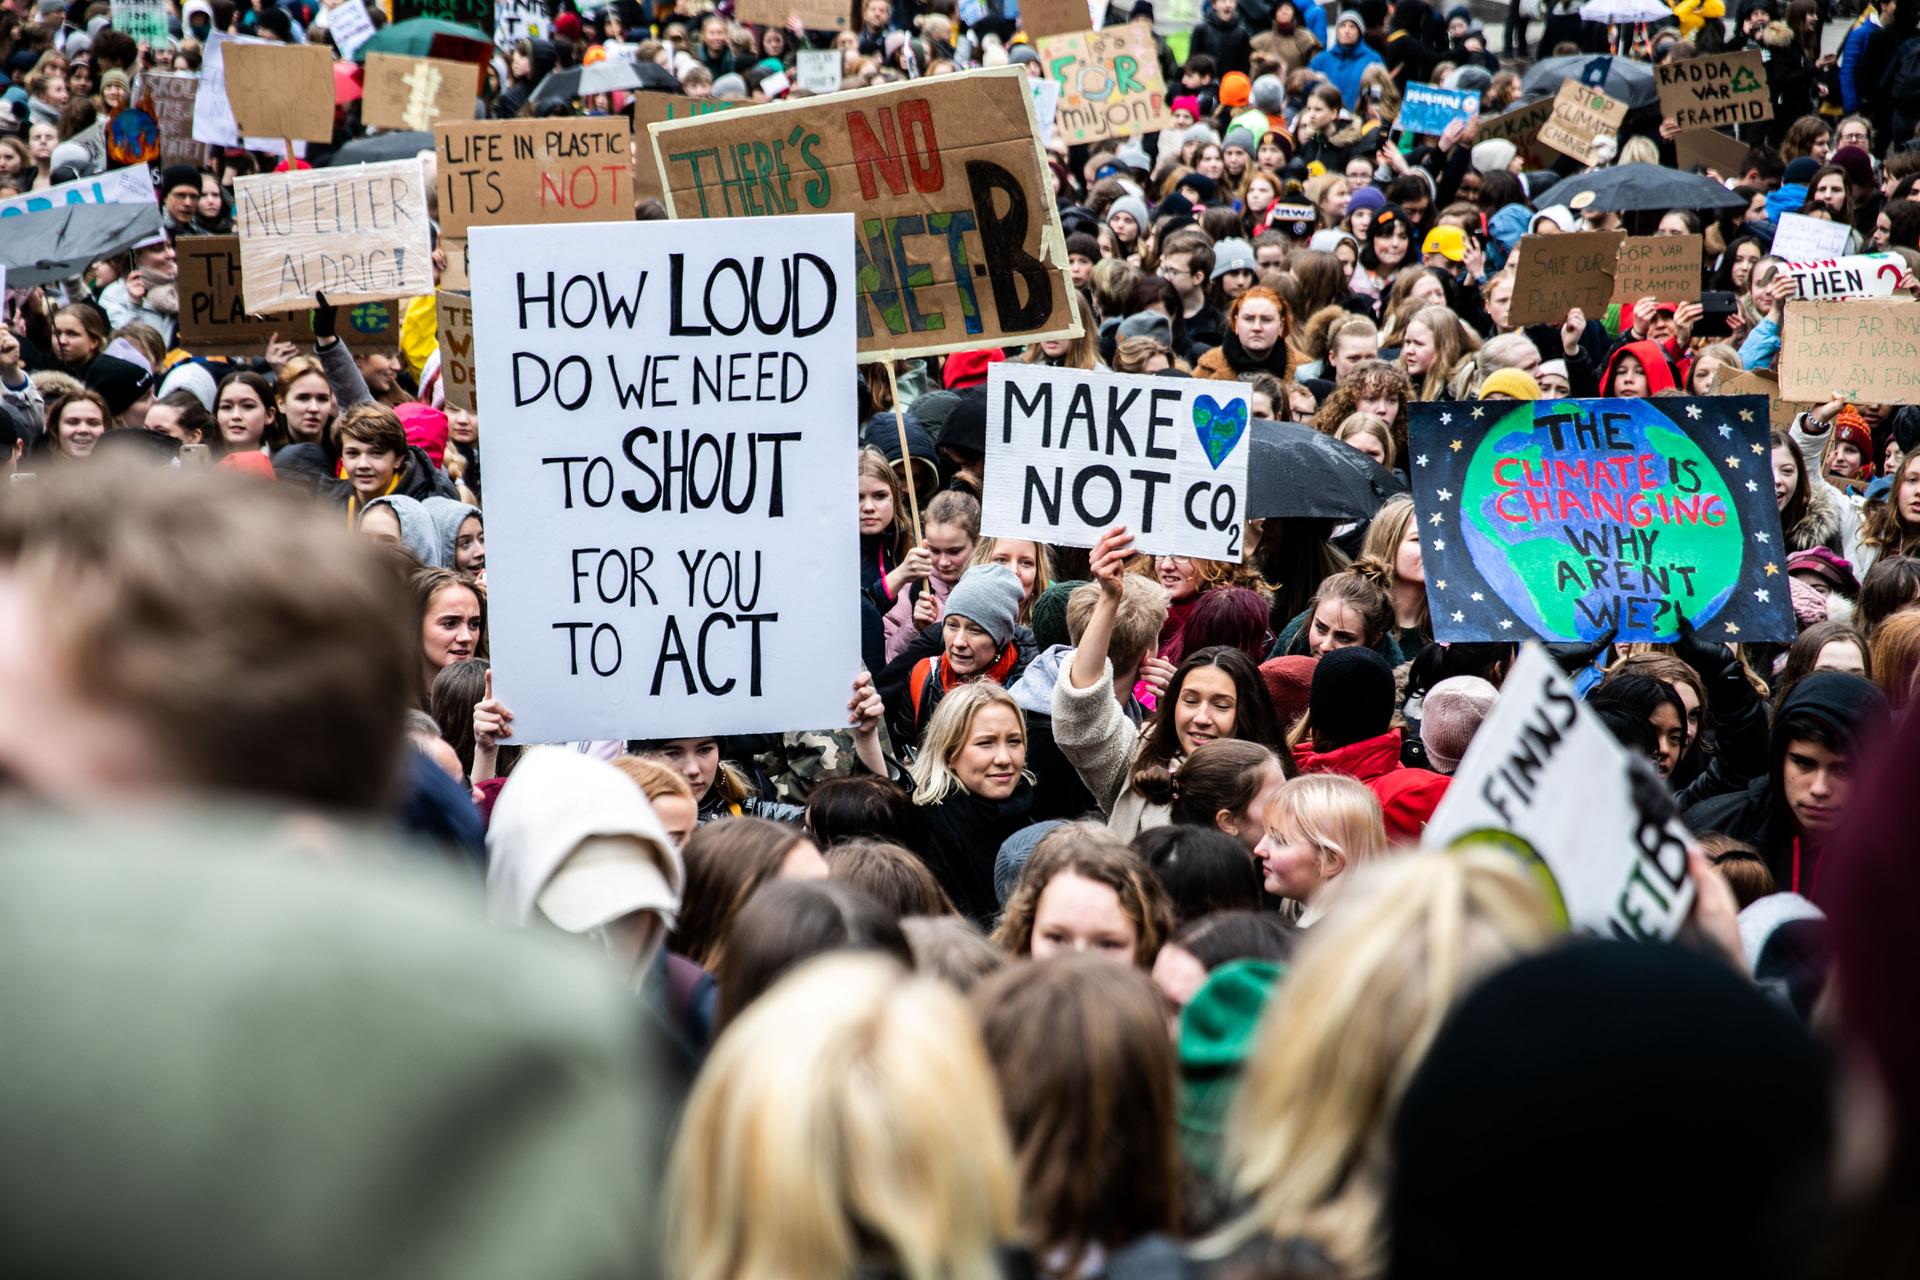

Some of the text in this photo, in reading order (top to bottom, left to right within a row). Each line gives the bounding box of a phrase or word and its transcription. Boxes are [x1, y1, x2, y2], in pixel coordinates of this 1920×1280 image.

[1659, 60, 1732, 86] RÄDDA
[1692, 83, 1731, 101] VÅR
[1575, 86, 1613, 114] STOP
[1676, 100, 1765, 126] FRAMTID
[445, 130, 625, 164] LIFE IN PLASTIC
[668, 99, 945, 218] THERE'S NO
[540, 164, 627, 210] NOT
[244, 183, 293, 238] NU
[1531, 248, 1605, 278] SAVE OUR
[516, 252, 837, 337] HOW LOUD
[1623, 278, 1690, 294] FRAMTID
[1791, 269, 1863, 298] THEN
[1803, 315, 1850, 338] DET
[1798, 336, 1918, 358] PLAST I VÅRA
[512, 351, 808, 411] DO WE NEED
[1796, 367, 1836, 387] HAV
[1003, 380, 1182, 460] MAKE
[1534, 413, 1635, 452] THE
[542, 426, 802, 518] TO SHOUT
[1493, 454, 1702, 493] CLIMATE IS
[1021, 465, 1171, 533] NOT
[1496, 490, 1727, 528] CHANGING
[1563, 524, 1659, 566] WHY
[571, 546, 761, 612] FOR YOU
[1556, 560, 1697, 597] AREN'T
[552, 611, 779, 697] TO ACT
[1481, 676, 1578, 826] FINNS
